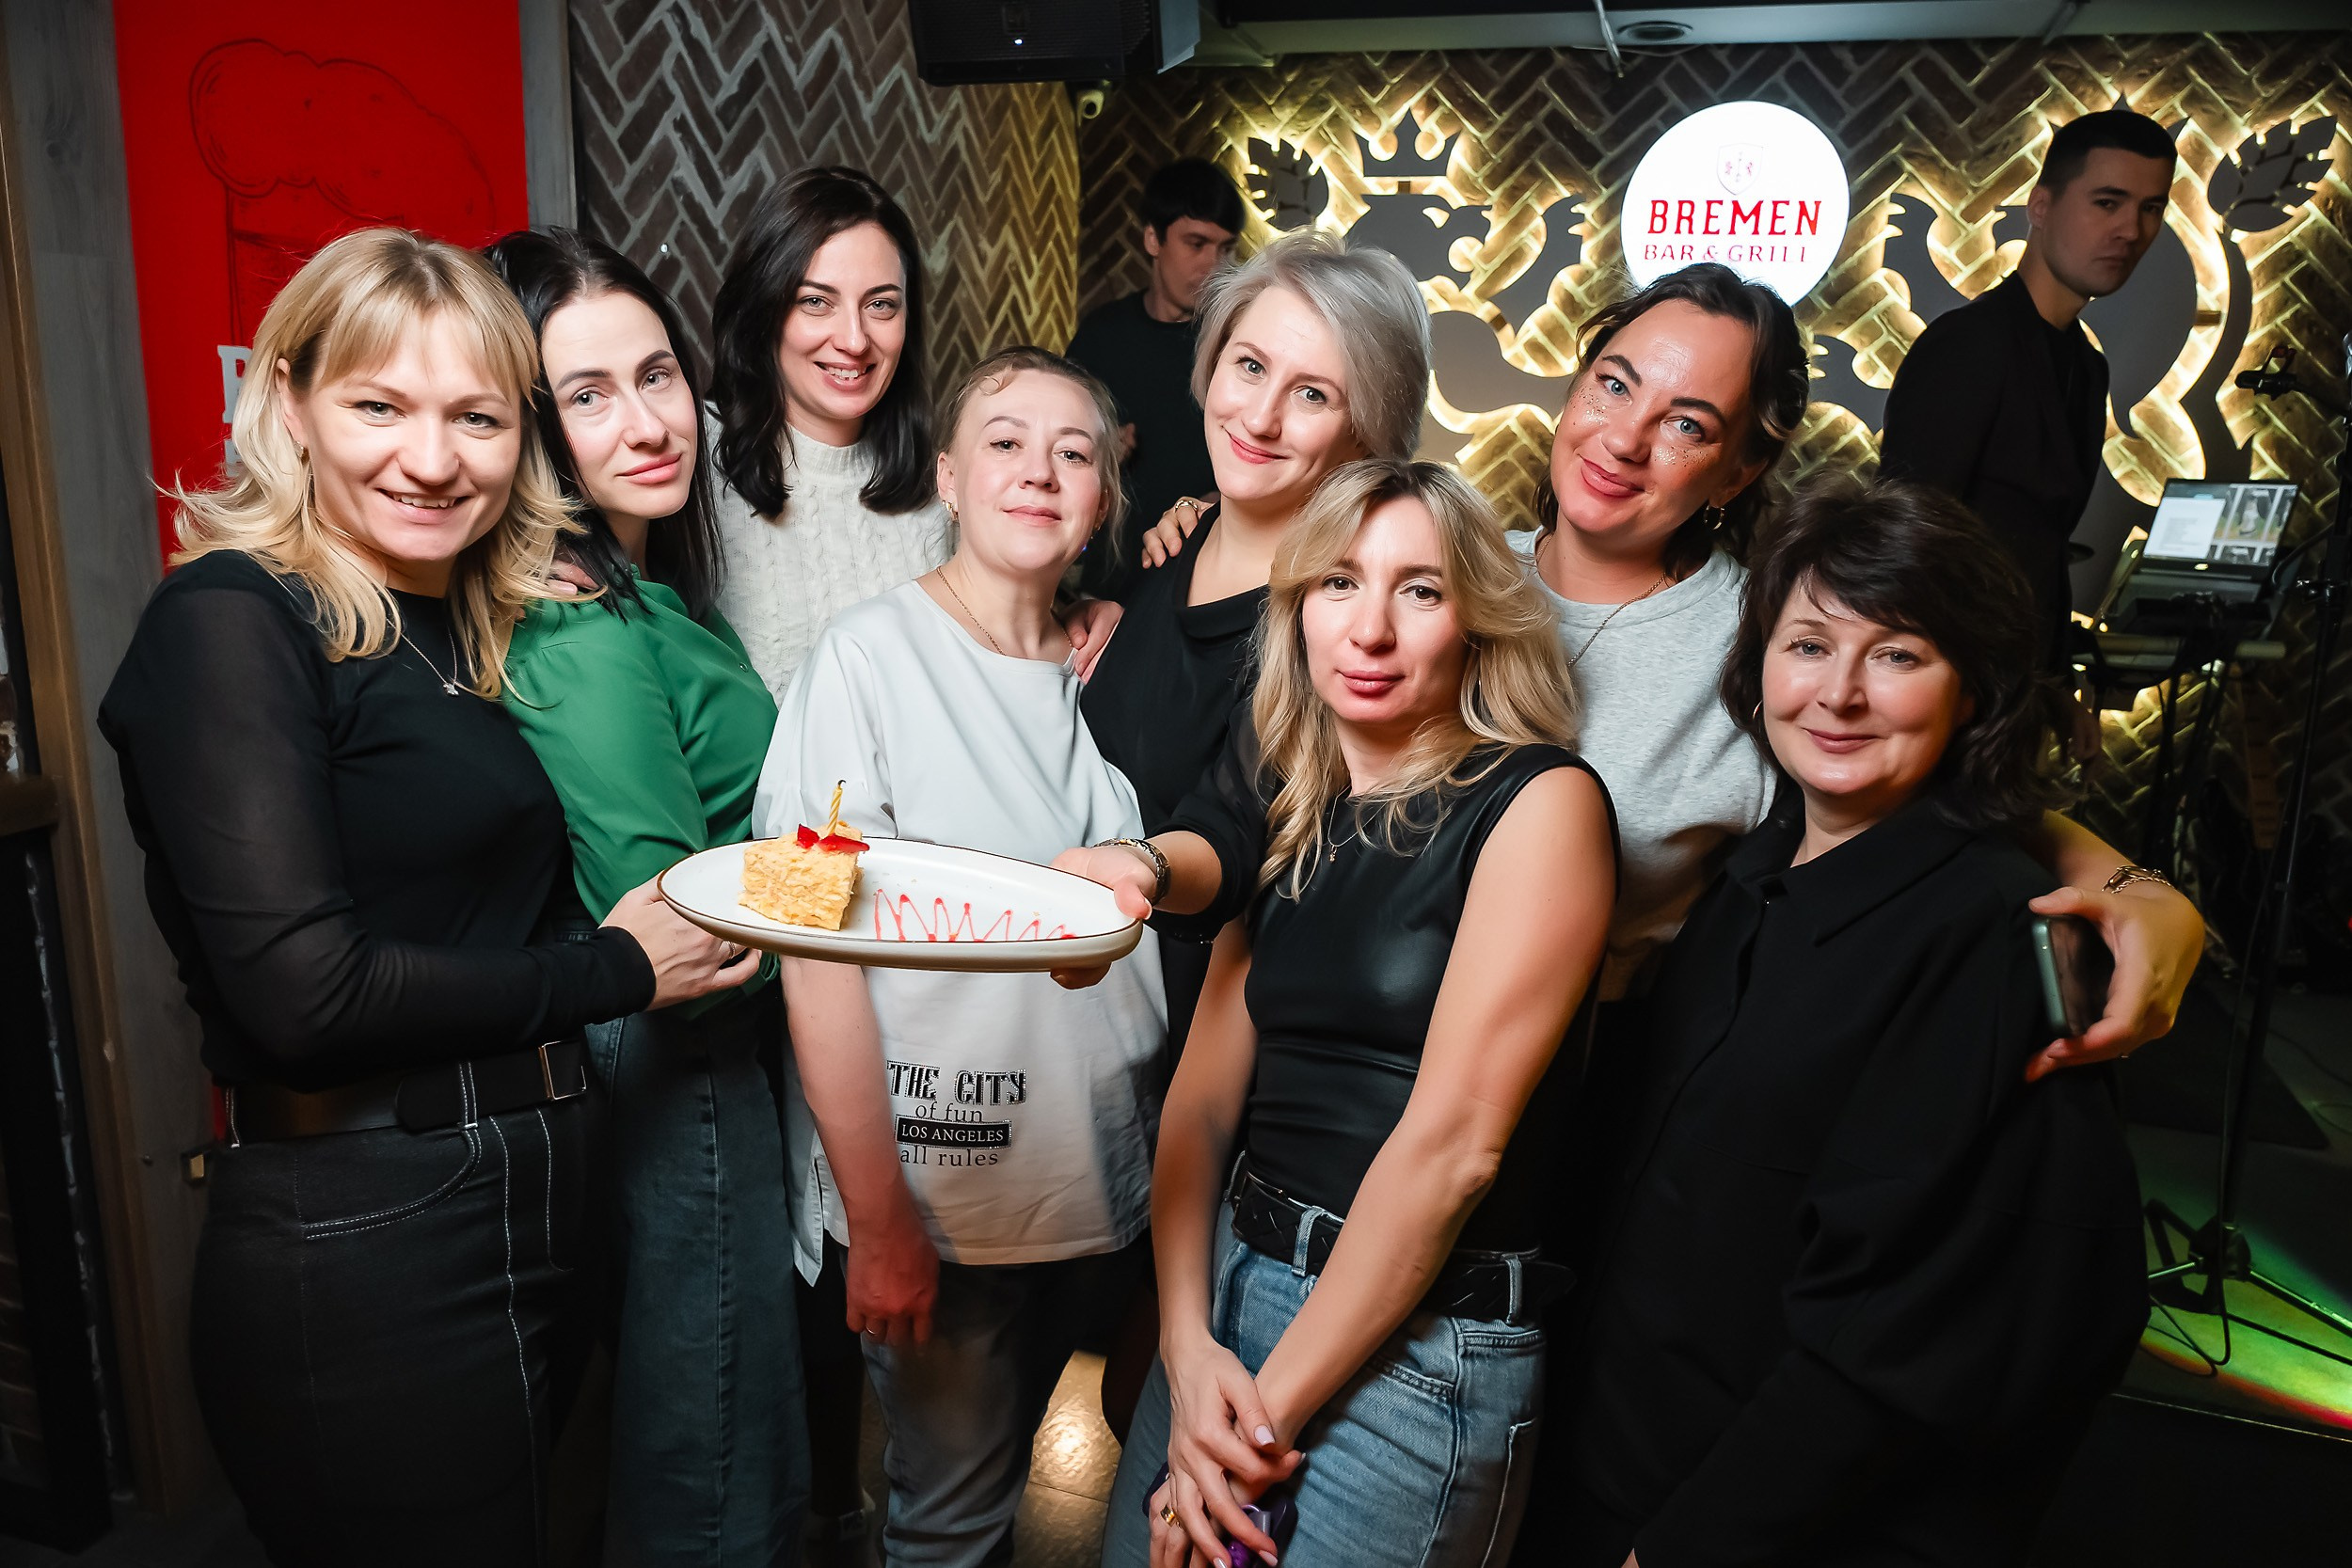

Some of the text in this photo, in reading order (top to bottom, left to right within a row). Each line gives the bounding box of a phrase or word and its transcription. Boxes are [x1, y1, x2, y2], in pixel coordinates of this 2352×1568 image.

[1647, 199, 1821, 236] BREMEN
[1645, 244, 1694, 261] BAR
[1702, 245, 1719, 262] &
[887, 1060, 1026, 1106] THE CITY
[915, 1101, 983, 1122] of fun
[901, 1125, 1004, 1142] LOS ANGELES
[899, 1145, 998, 1167] all rules
